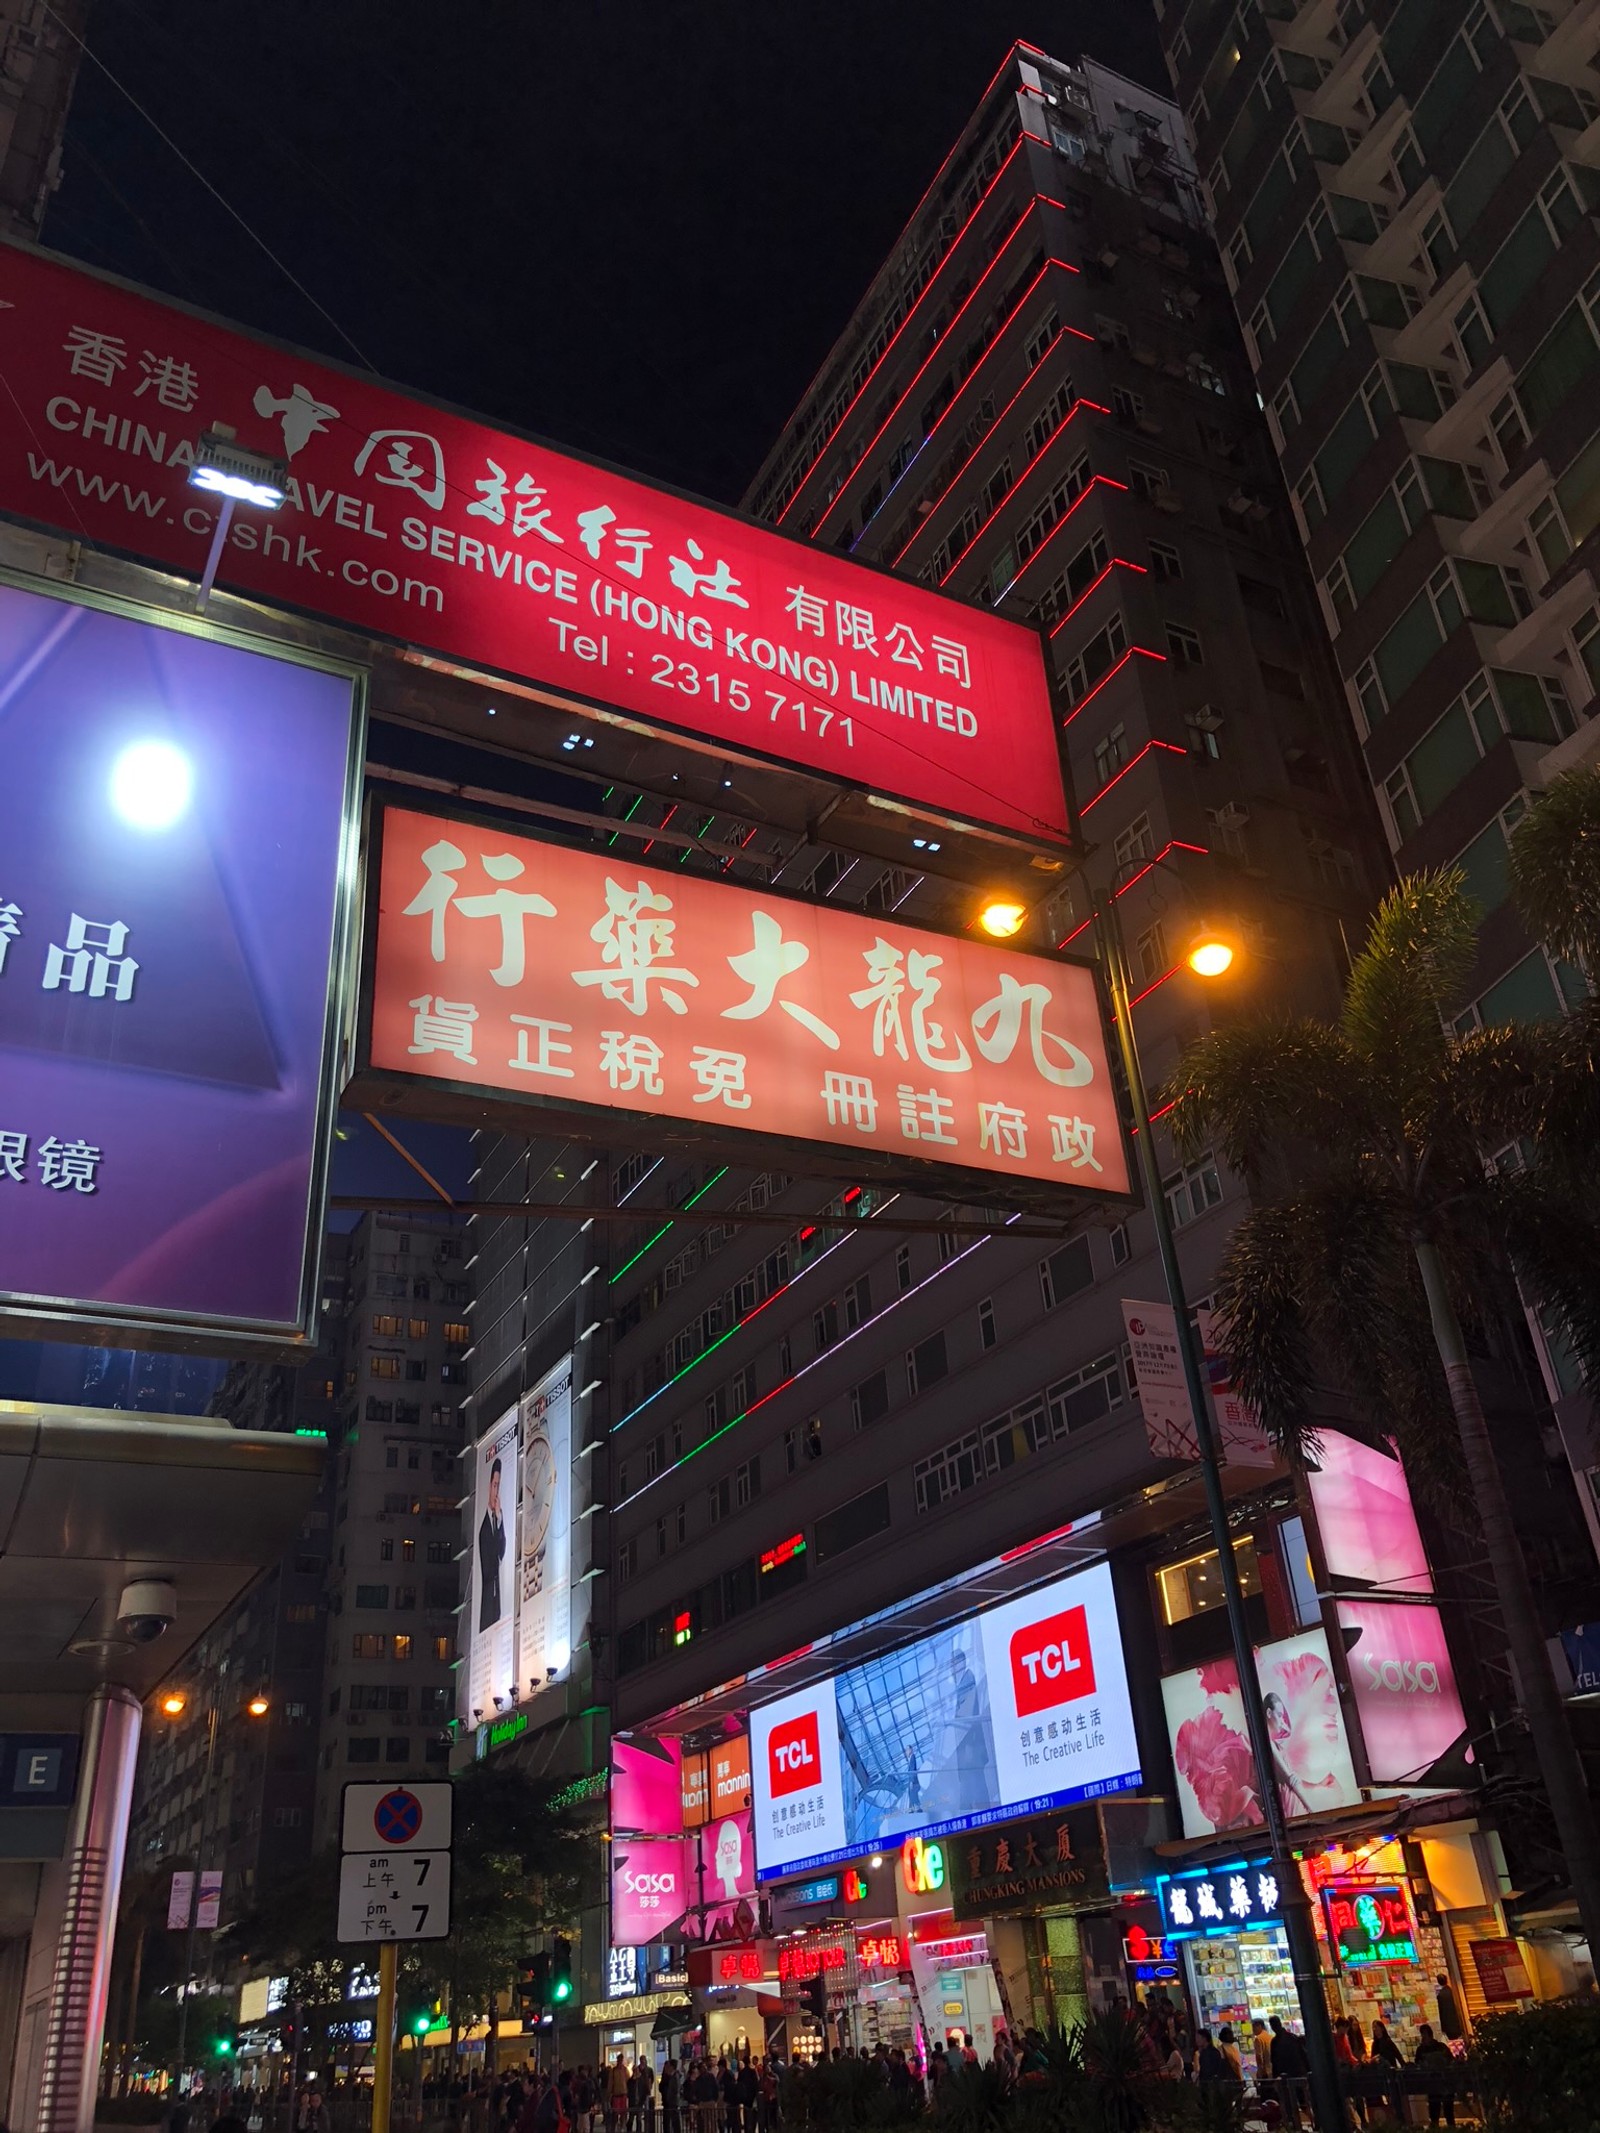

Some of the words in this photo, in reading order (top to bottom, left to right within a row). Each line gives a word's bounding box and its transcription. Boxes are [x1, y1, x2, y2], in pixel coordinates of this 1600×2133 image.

[62, 324, 200, 413] 香港
[785, 583, 972, 689] 有限公司
[26, 452, 445, 613] www.cshk.com
[46, 396, 197, 468] CHINA
[402, 516, 578, 605] SERVICE
[590, 578, 713, 651] (HONG
[725, 628, 840, 697] KONG)
[851, 670, 979, 739] LIMITED
[549, 617, 609, 668] Tel
[651, 653, 751, 713] 2315
[765, 690, 856, 747] 7171
[546, 1376, 570, 1405] TISSOT
[1021, 1640, 1081, 1684] TCL
[1020, 1708, 1102, 1748] 创意感动生活
[775, 1740, 813, 1773] TCL
[1022, 1751, 1040, 1767] The
[1042, 1739, 1082, 1762] Creative
[1086, 1732, 1105, 1750] Life
[29, 1756, 48, 1784] E
[773, 1827, 784, 1840] The
[786, 1819, 811, 1836] Creative
[813, 1813, 826, 1829] Life
[369, 1858, 389, 1868] am
[413, 1858, 431, 1886] 7
[363, 1872, 394, 1888] 上午
[1027, 1868, 1086, 1893] MANSIONS
[367, 1904, 387, 1917] pm
[412, 1904, 429, 1932] 7
[360, 1919, 392, 1935] 下午
